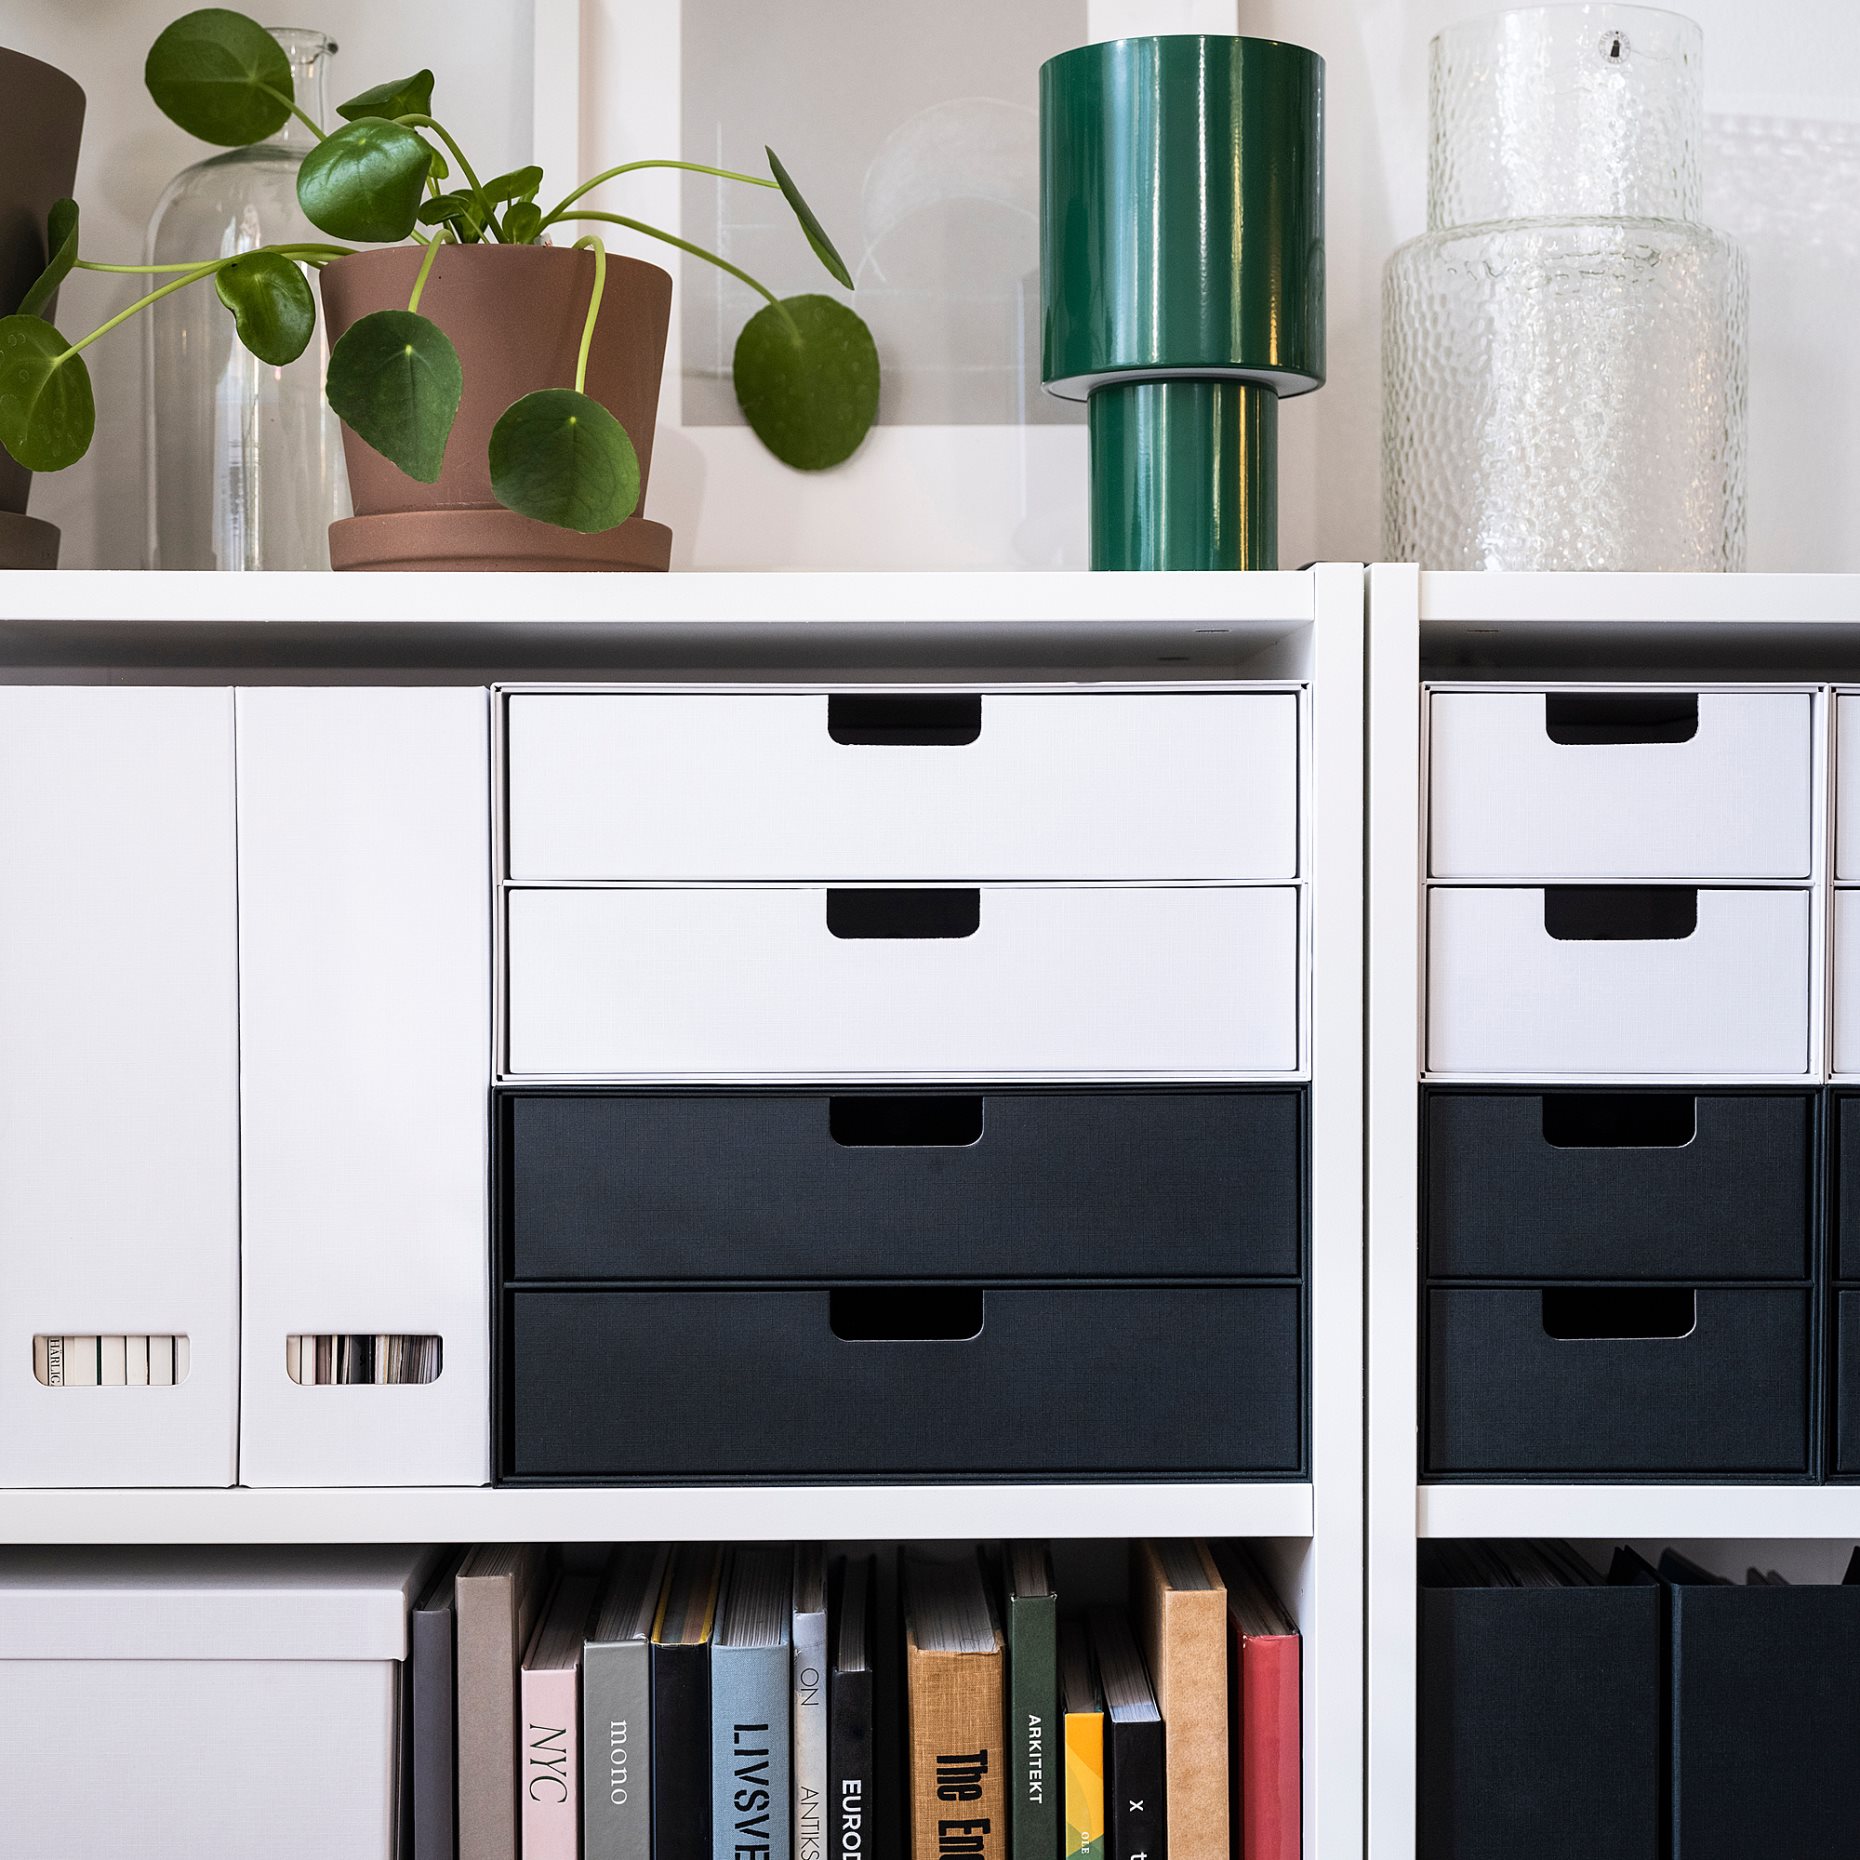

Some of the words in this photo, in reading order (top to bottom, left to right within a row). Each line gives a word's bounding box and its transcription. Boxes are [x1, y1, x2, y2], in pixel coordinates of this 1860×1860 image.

[50, 1339, 62, 1386] HÄRLIG
[800, 1667, 820, 1706] ON
[529, 1723, 568, 1803] NYC
[610, 1719, 628, 1805] mono
[733, 1723, 770, 1860] LIVSVE
[936, 1749, 988, 1801] The
[1028, 1714, 1043, 1804] ARKITEKT
[800, 1786, 820, 1860] ANTIKS
[1081, 1831, 1090, 1855] OLE
